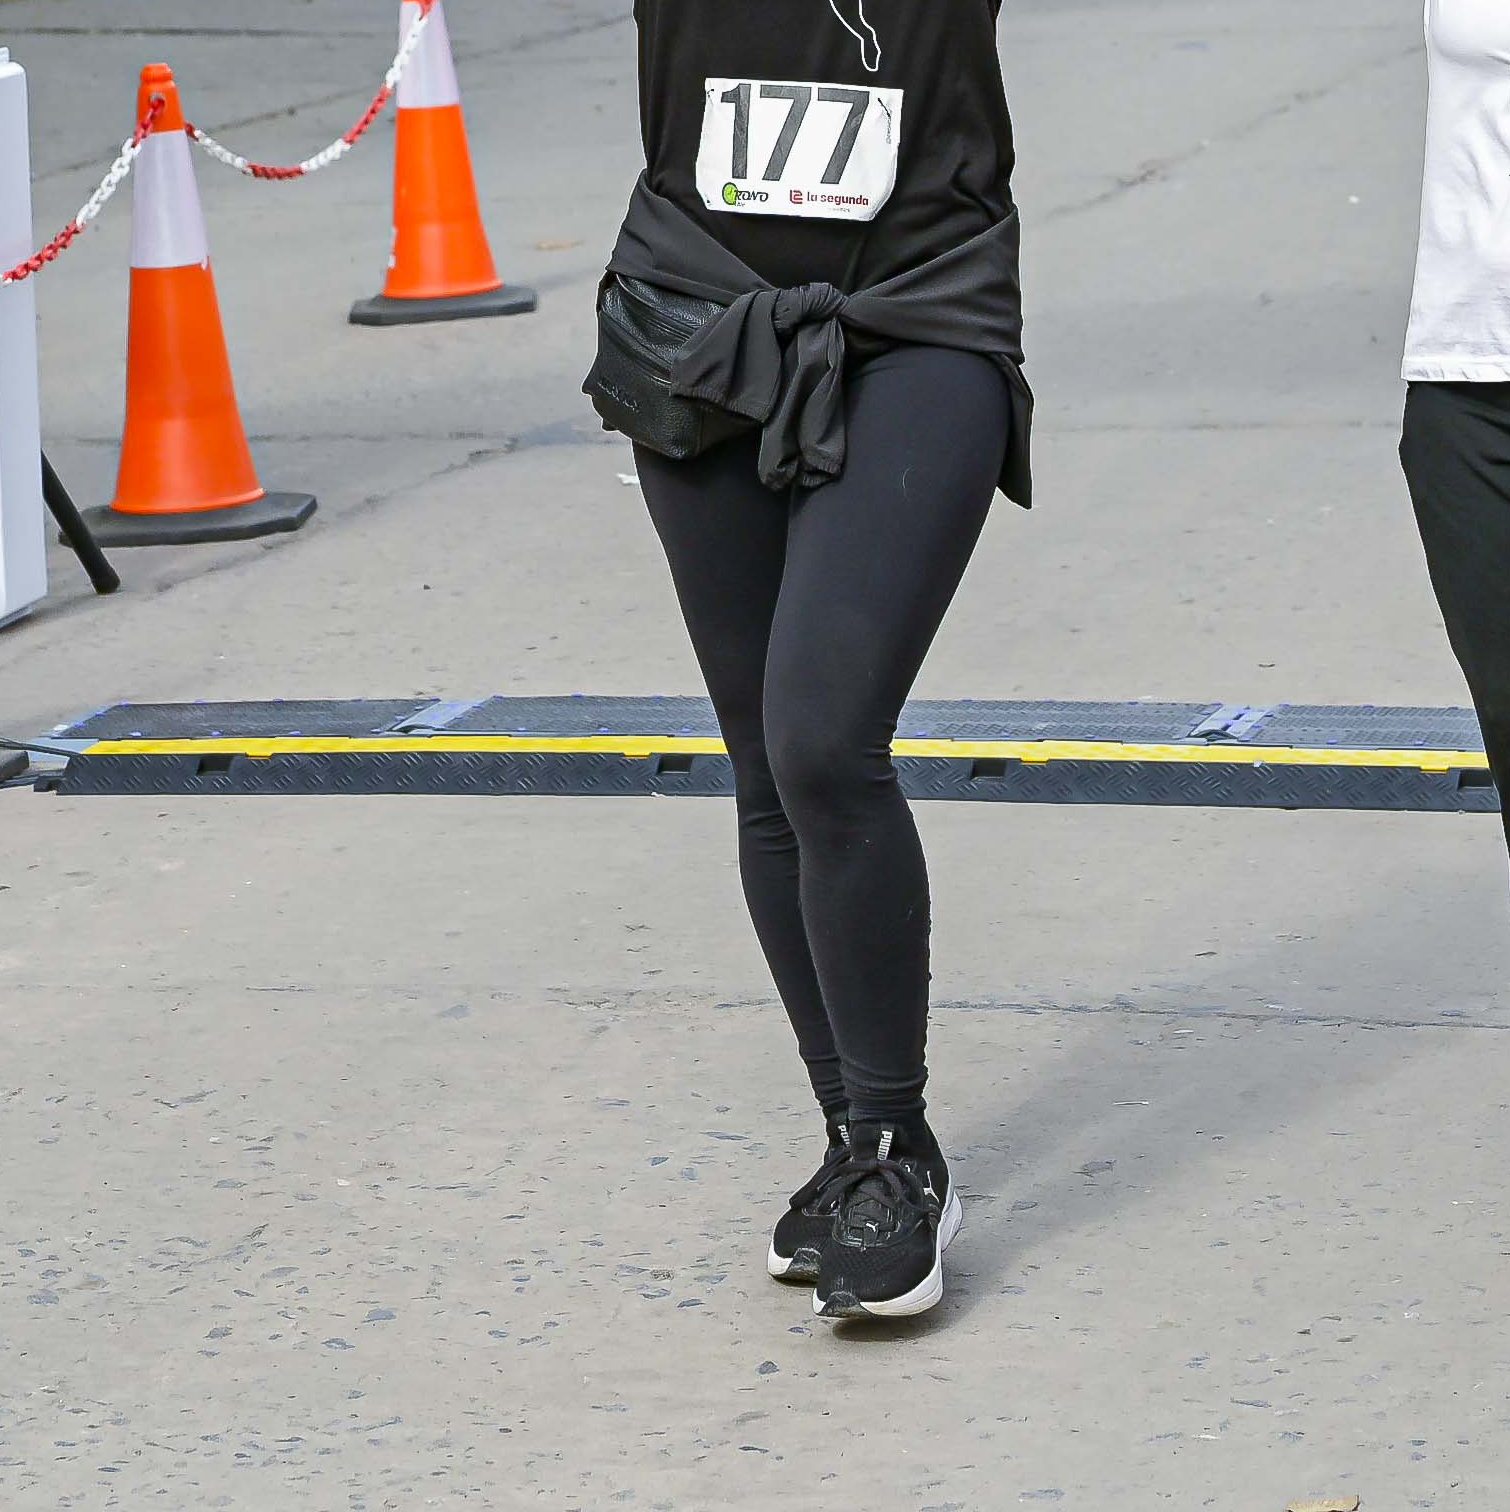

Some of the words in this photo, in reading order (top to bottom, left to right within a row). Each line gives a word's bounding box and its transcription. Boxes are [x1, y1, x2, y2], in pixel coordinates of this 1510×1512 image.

[720, 83, 871, 185] 177
[807, 191, 818, 202] la
[820, 195, 869, 206] segunda
